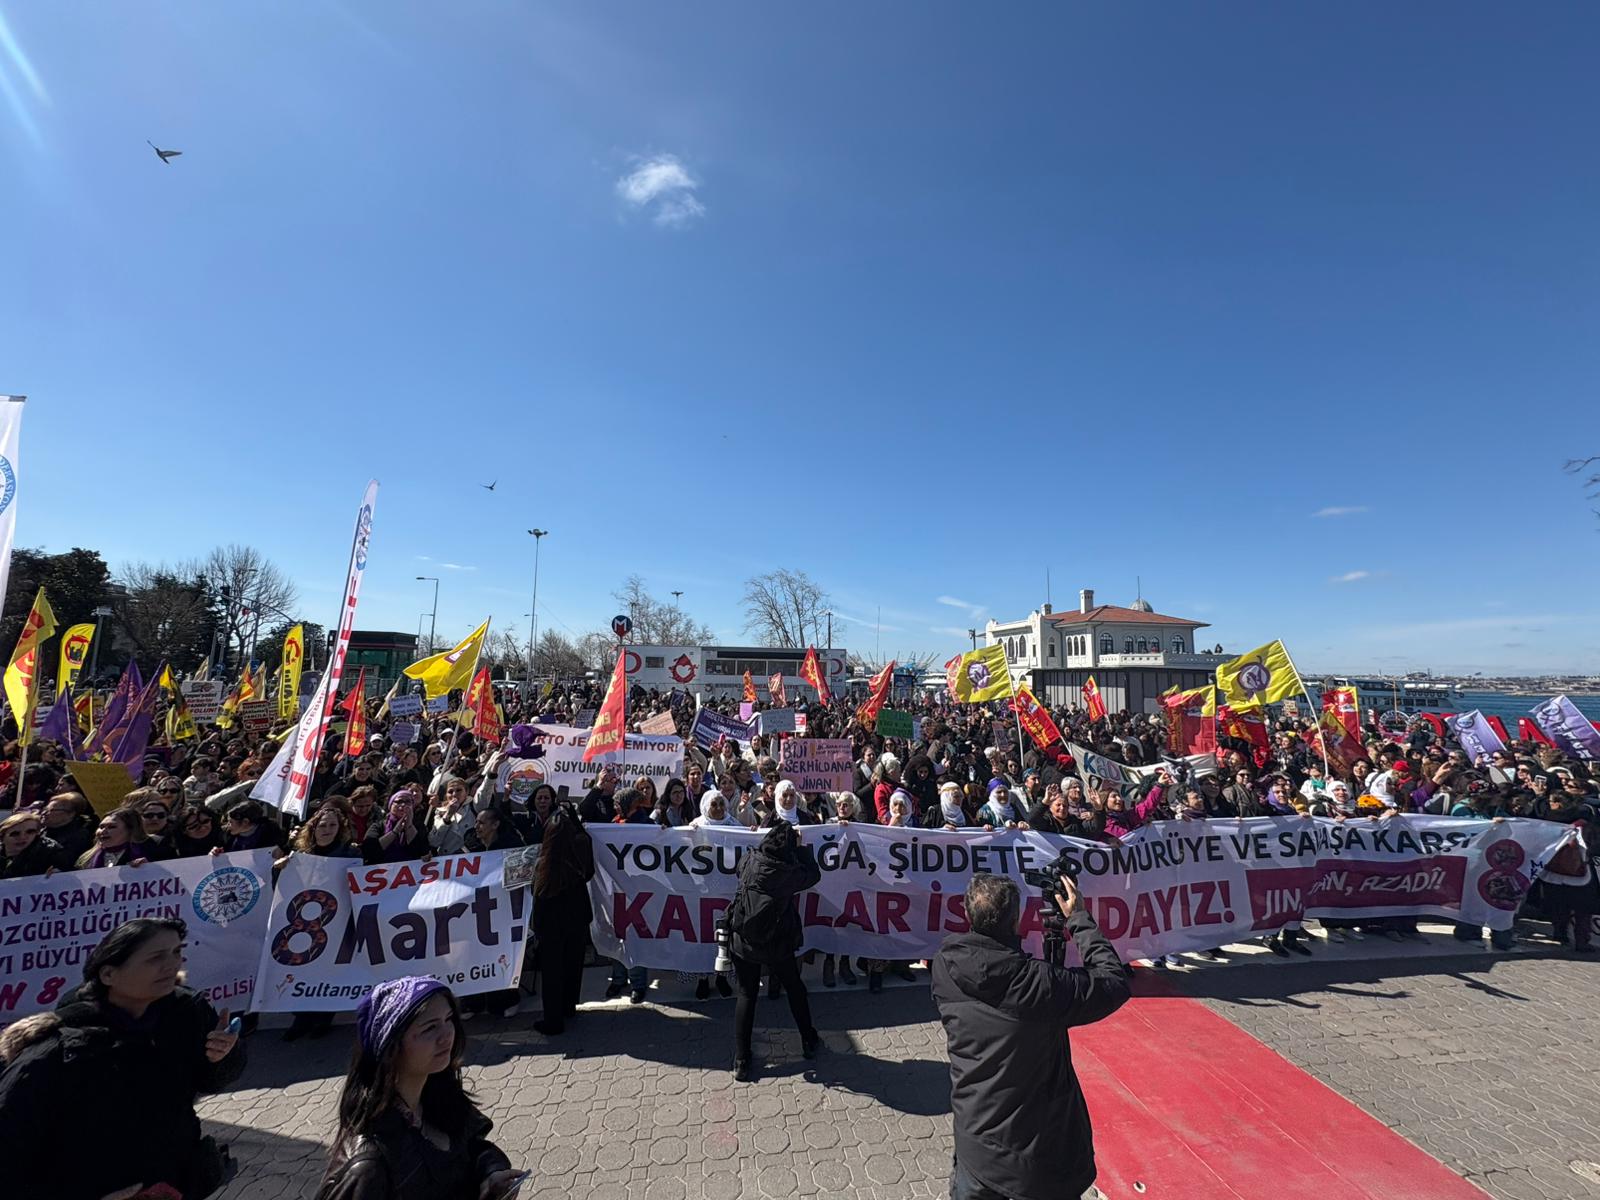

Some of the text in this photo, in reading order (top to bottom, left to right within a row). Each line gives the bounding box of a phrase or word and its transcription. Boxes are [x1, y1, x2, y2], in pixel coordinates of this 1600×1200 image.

[606, 834, 877, 876] YOKSUĞA,
[1229, 833, 1272, 860] VE
[347, 855, 482, 896] AŞASIN
[30, 886, 106, 916] YAŞAM
[113, 876, 187, 903] HAKKI,
[613, 880, 1235, 944] KADLAR İSADAYIZ!
[0, 906, 129, 946] ZGÜRLÜĞÜ
[271, 889, 338, 966] 8
[334, 885, 526, 966] Mart!
[36, 976, 66, 1004] 8
[291, 981, 376, 999] Sultanga
[469, 963, 497, 981] Gül
